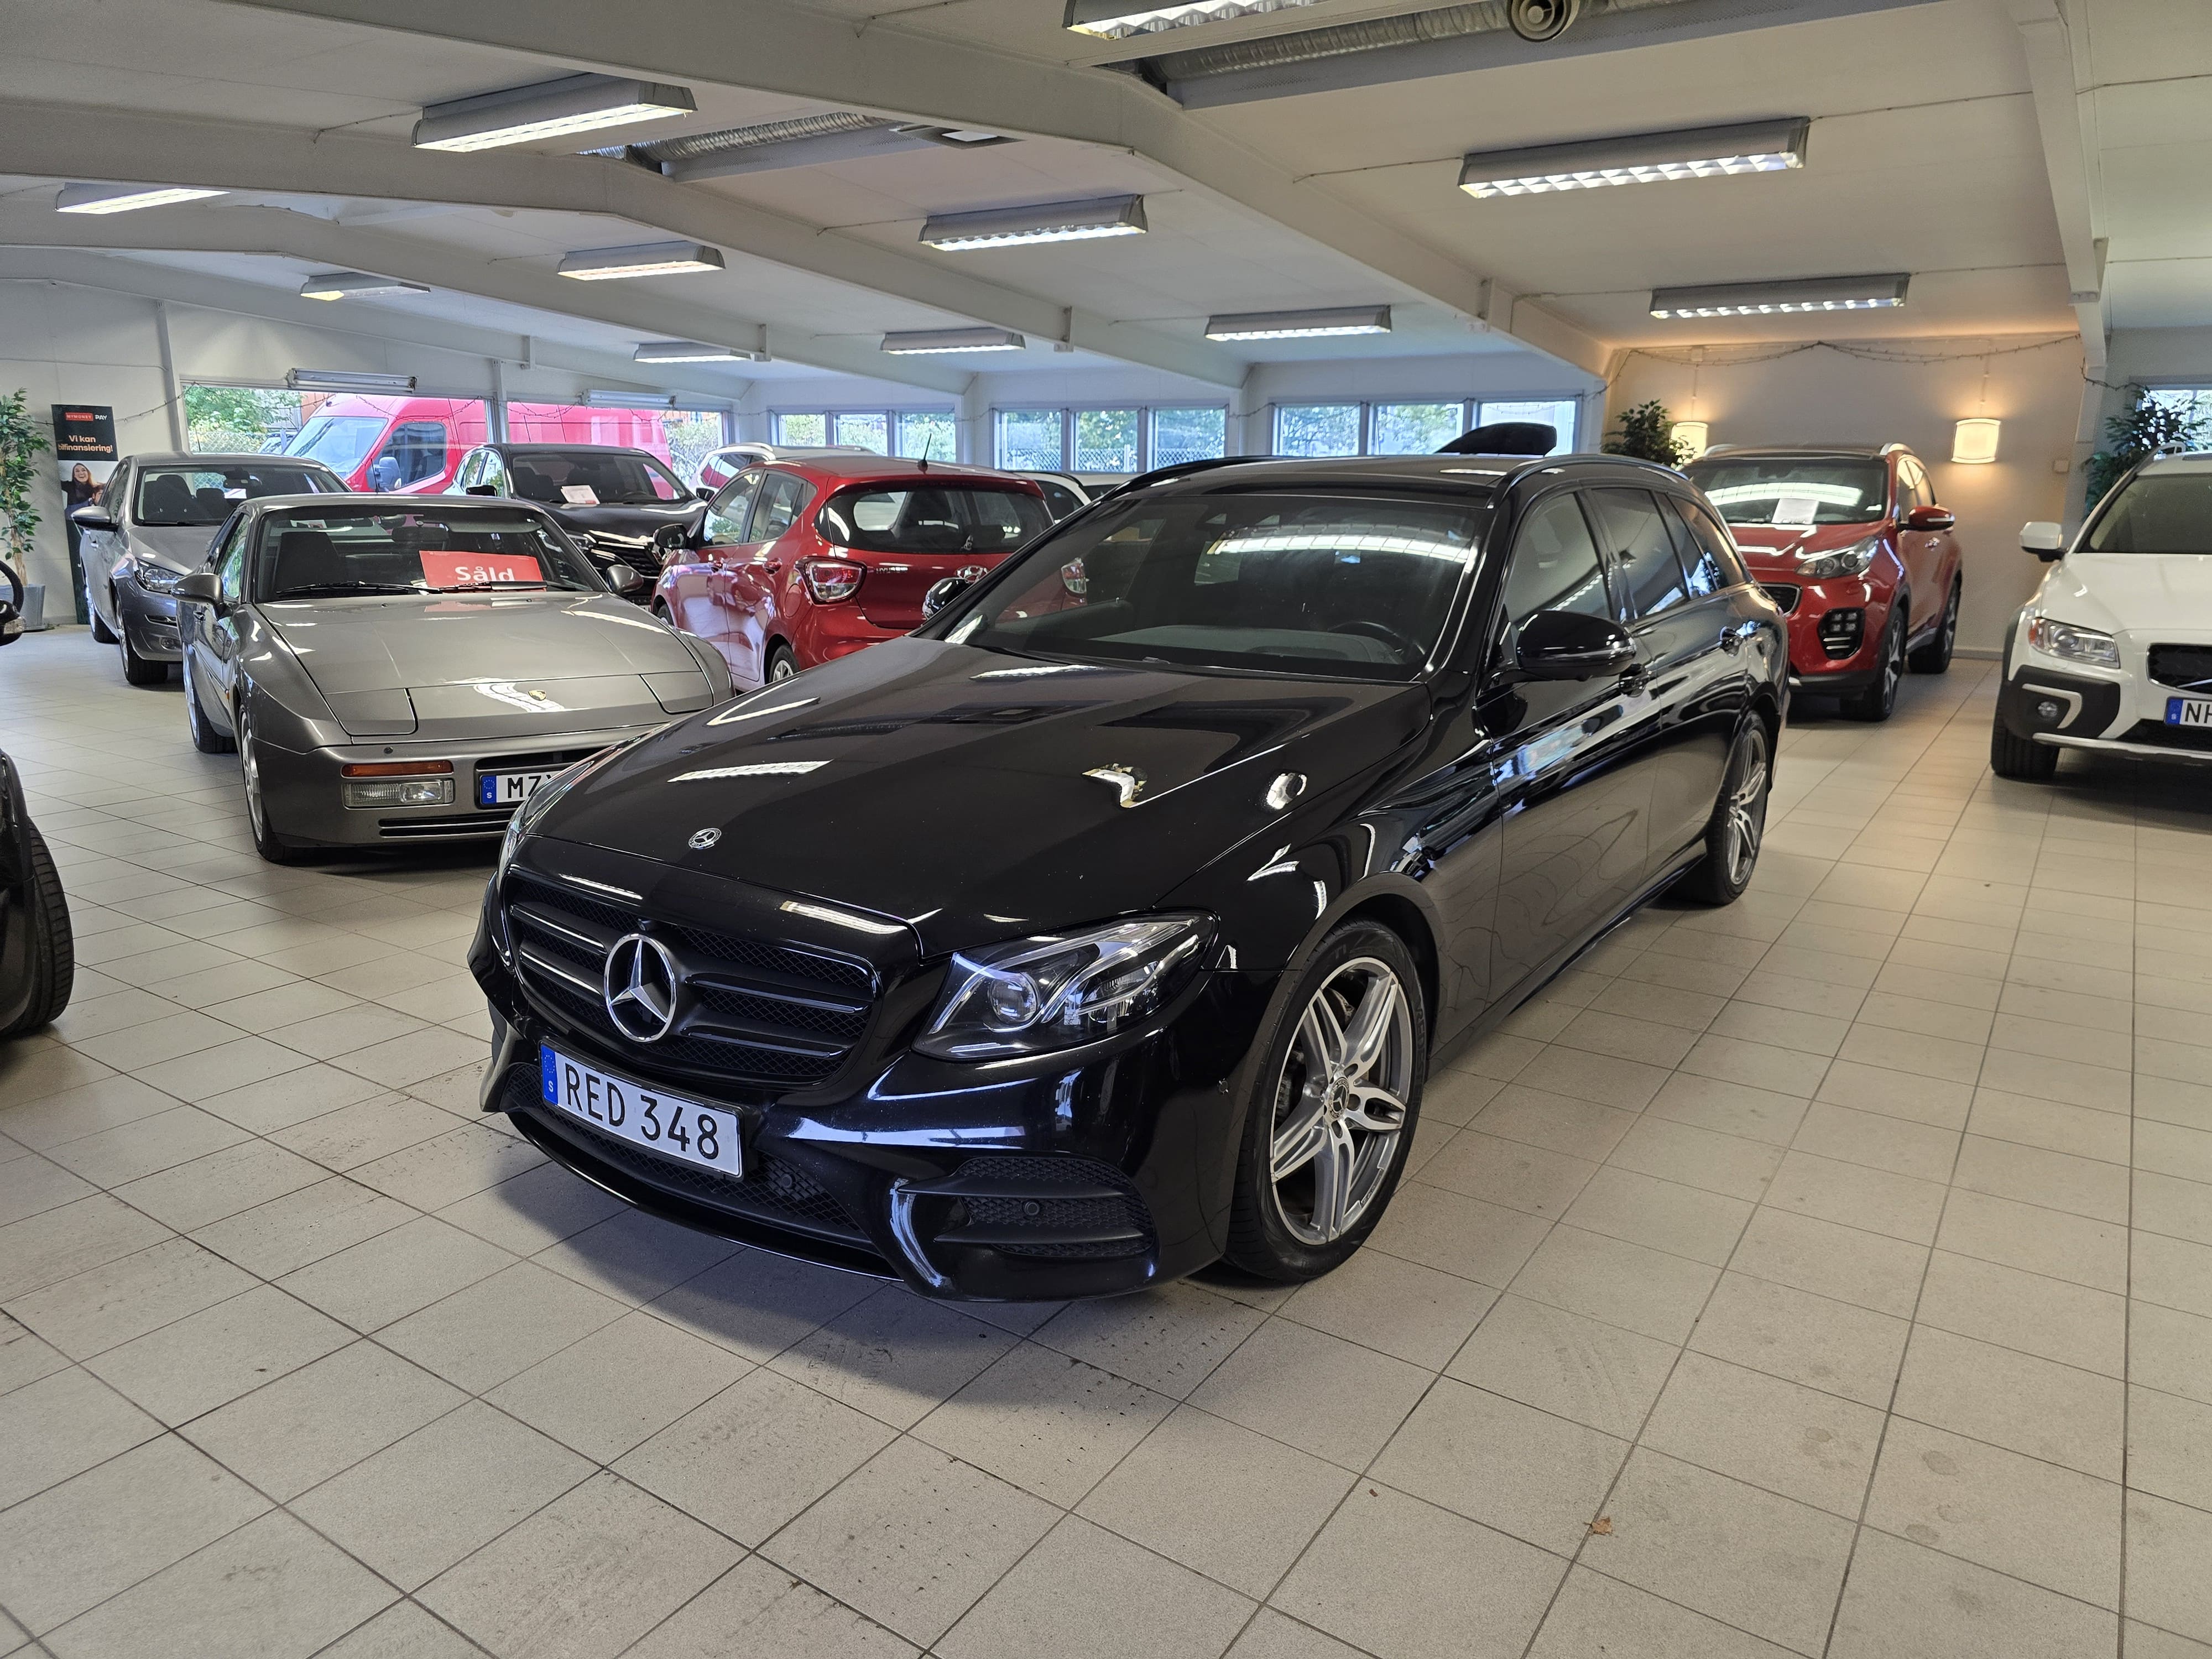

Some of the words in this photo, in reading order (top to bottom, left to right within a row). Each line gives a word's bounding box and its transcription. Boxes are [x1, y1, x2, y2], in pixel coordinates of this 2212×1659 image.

[455, 566, 515, 581] Såld
[507, 774, 552, 799] MZ
[548, 1080, 554, 1093] S
[565, 1062, 625, 1127] RED
[640, 1094, 719, 1160] 348
